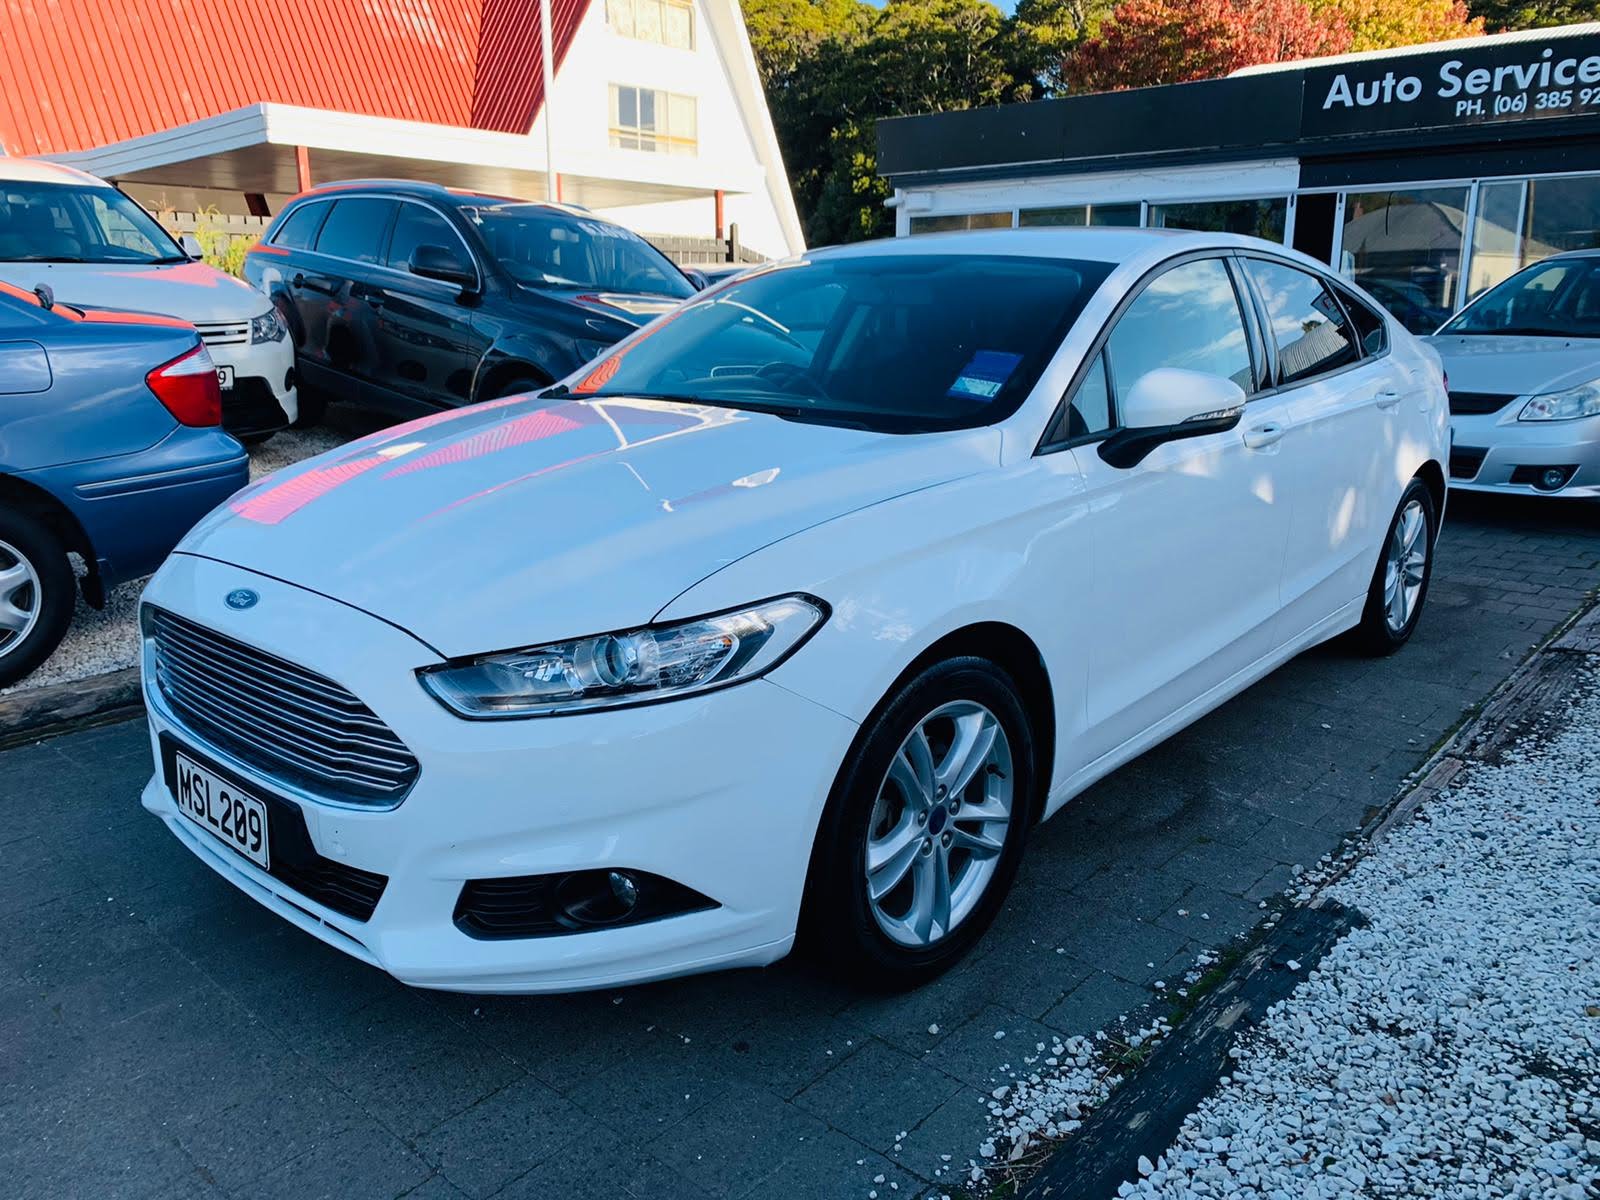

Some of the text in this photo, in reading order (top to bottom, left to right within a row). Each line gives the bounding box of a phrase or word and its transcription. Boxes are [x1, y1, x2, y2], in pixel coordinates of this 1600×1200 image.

[1322, 48, 1600, 109] Auto Service
[1456, 99, 1486, 117] PH.
[1494, 92, 1527, 116] (06)
[1535, 90, 1573, 109] 385
[179, 763, 262, 853] MSL209
